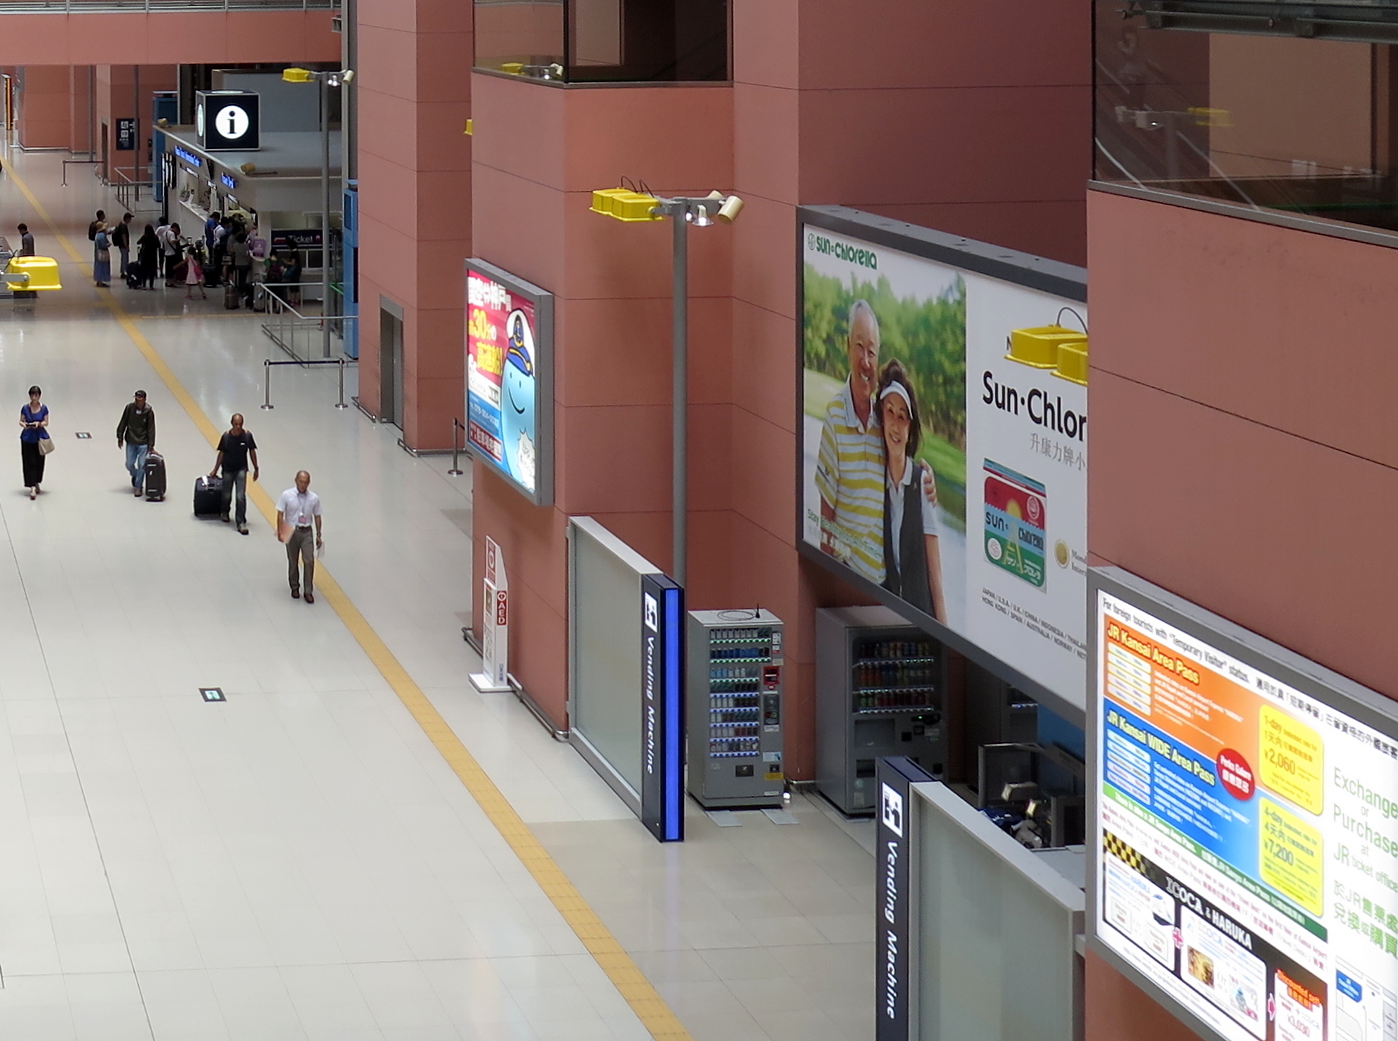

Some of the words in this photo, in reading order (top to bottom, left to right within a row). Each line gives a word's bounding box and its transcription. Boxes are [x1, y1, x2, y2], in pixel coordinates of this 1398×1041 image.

[1107, 621, 1119, 642] JR
[1121, 629, 1150, 658] Kansai
[1153, 646, 1173, 671] Area
[1176, 657, 1199, 685] Pass
[1113, 603, 1130, 623] foreign
[1133, 614, 1153, 633] tourists
[1155, 625, 1166, 640] with
[646, 636, 656, 701] Vending
[647, 705, 656, 775] Machine
[1107, 708, 1118, 727] JR
[1119, 715, 1145, 744] Kansai
[1147, 732, 1169, 759] WIDE
[1172, 746, 1191, 772] Area
[1194, 760, 1215, 786] Pass
[1264, 744, 1295, 777] ¥2,060
[1334, 766, 1398, 820] Exchange
[1334, 803, 1398, 858] Purchase
[1334, 842, 1350, 867] JR
[883, 840, 898, 925] Vending
[1165, 875, 1203, 916] ICOCA
[1212, 908, 1251, 950] HARUKA
[886, 930, 898, 1020] Machine
